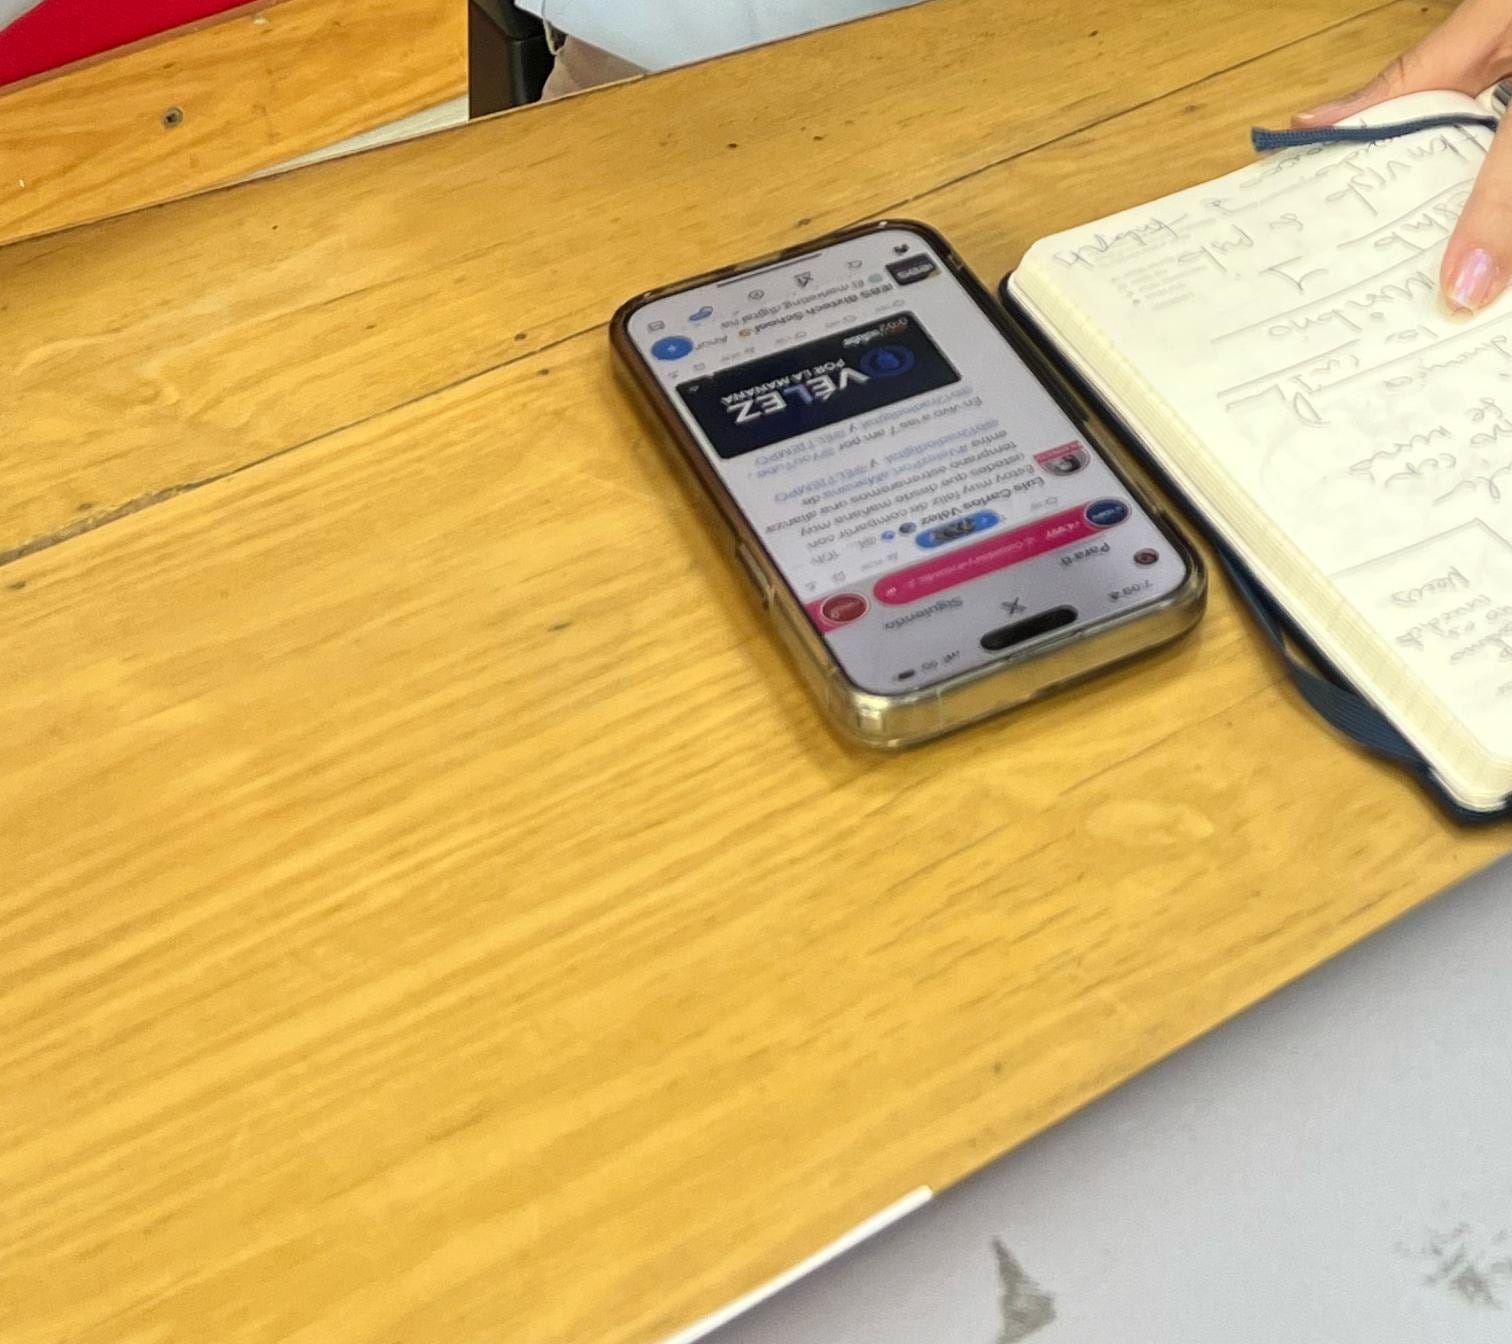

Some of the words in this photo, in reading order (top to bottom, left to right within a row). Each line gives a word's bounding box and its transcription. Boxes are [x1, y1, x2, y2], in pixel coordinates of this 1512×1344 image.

[813, 358, 845, 373] POR
[721, 376, 789, 404] MAÑANA
[727, 368, 867, 422] VÉLEZ
